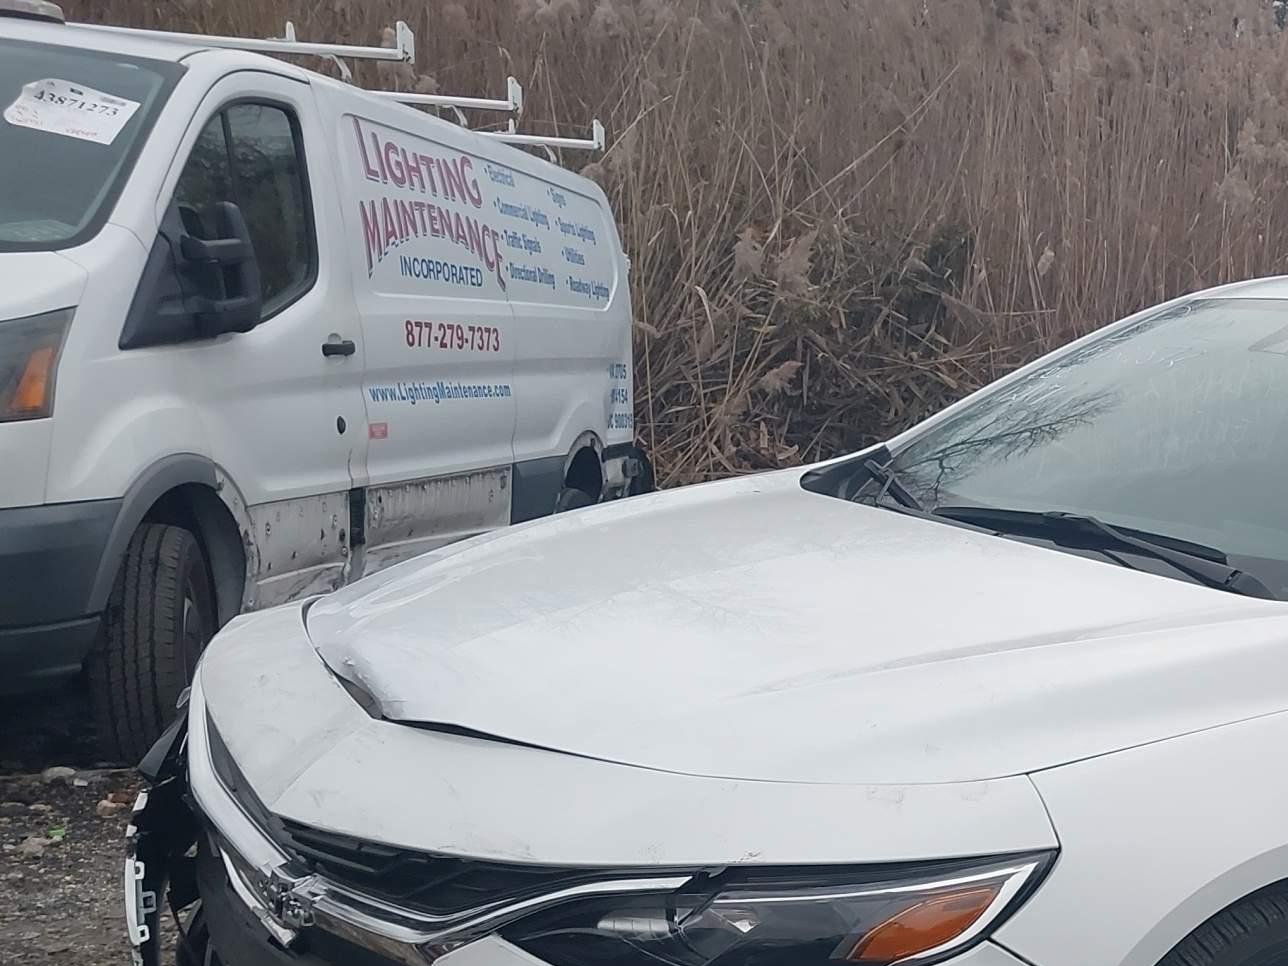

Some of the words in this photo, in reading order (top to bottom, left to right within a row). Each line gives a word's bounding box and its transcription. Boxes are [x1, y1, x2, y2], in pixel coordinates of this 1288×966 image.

[353, 116, 483, 209] LIGHTING
[360, 197, 507, 292] MAINTENANCE
[400, 255, 484, 288] INCORPORATED
[404, 319, 501, 352] 877-279-7373
[369, 381, 512, 406] www.LightingMaintenance.com
